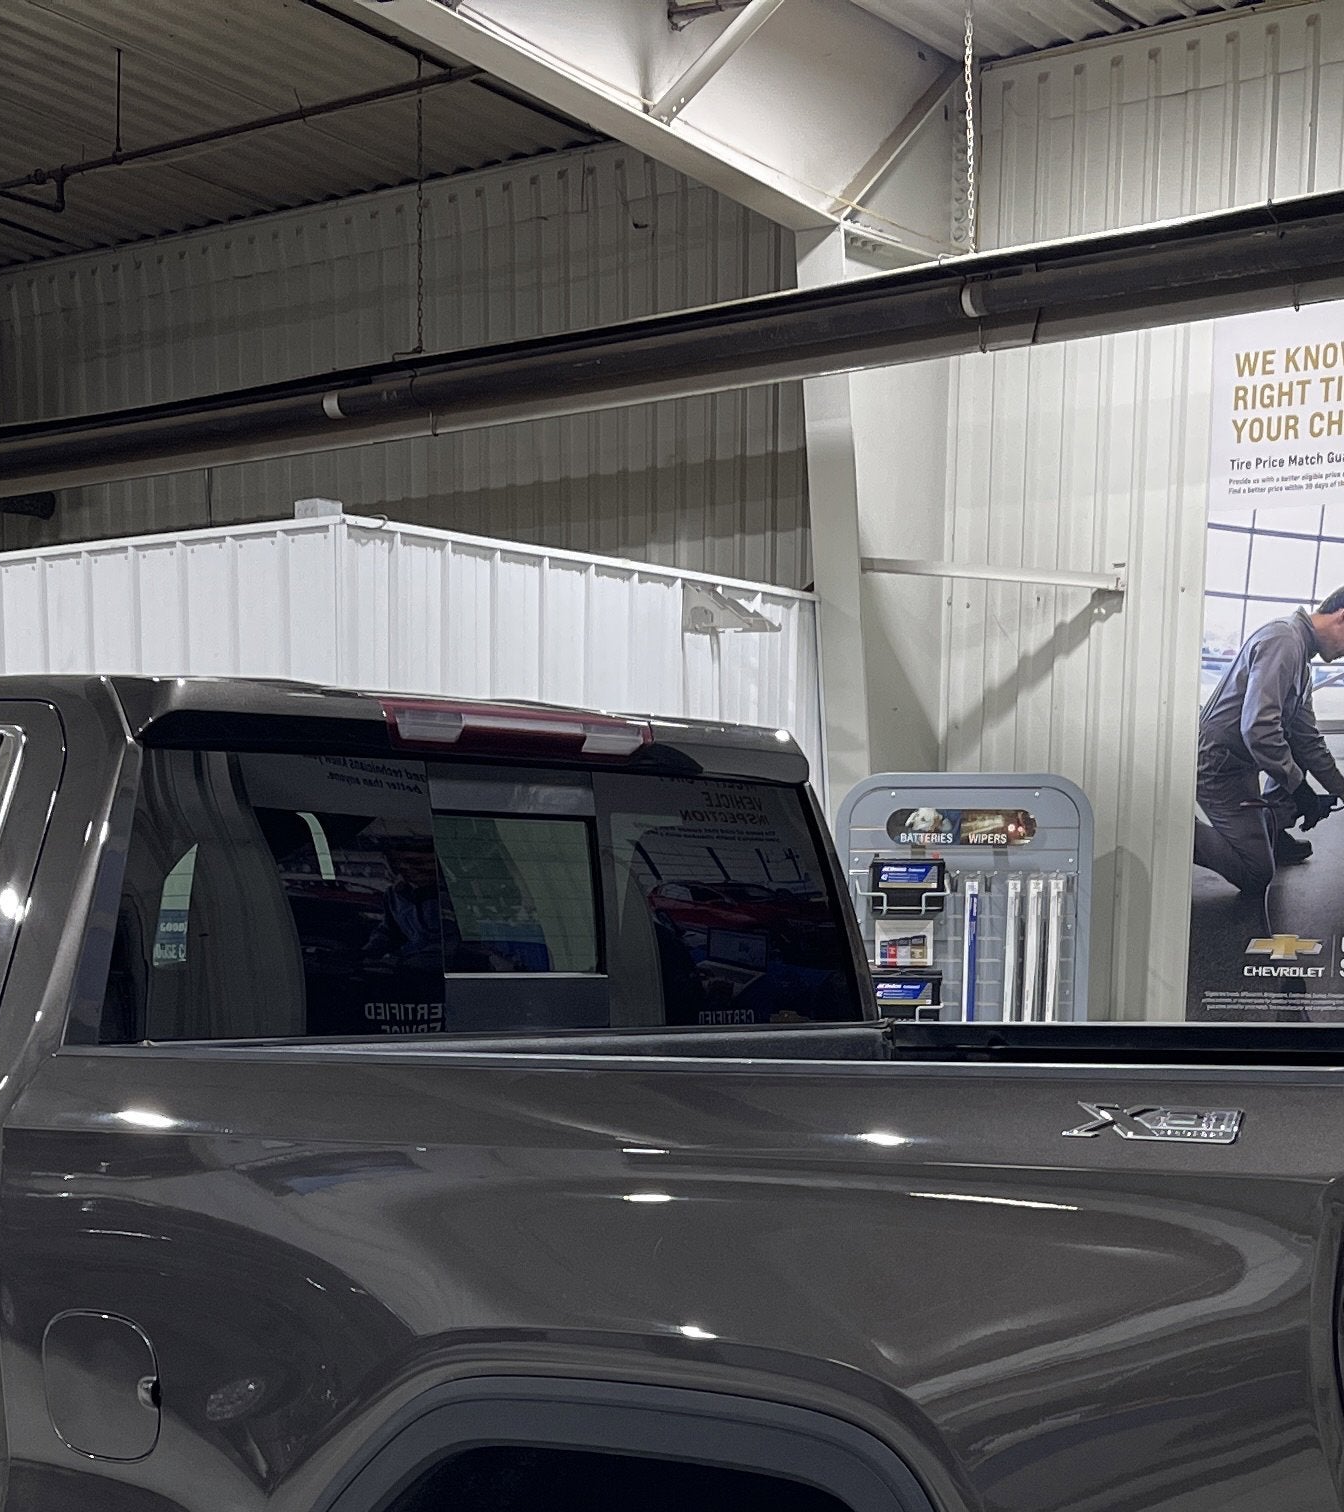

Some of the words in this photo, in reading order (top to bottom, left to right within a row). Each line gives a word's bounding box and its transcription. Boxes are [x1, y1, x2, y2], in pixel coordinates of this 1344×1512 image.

[1235, 350, 1276, 378] WE
[1233, 380, 1312, 411] RIGHT
[1231, 415, 1300, 444] YOUR
[1229, 458, 1252, 471] Tire
[1255, 455, 1285, 469] Price
[1288, 452, 1323, 466] Match
[900, 833, 953, 844] BATTERIES
[968, 834, 1007, 845] WIPERS
[1243, 965, 1326, 979] CHEVROLET
